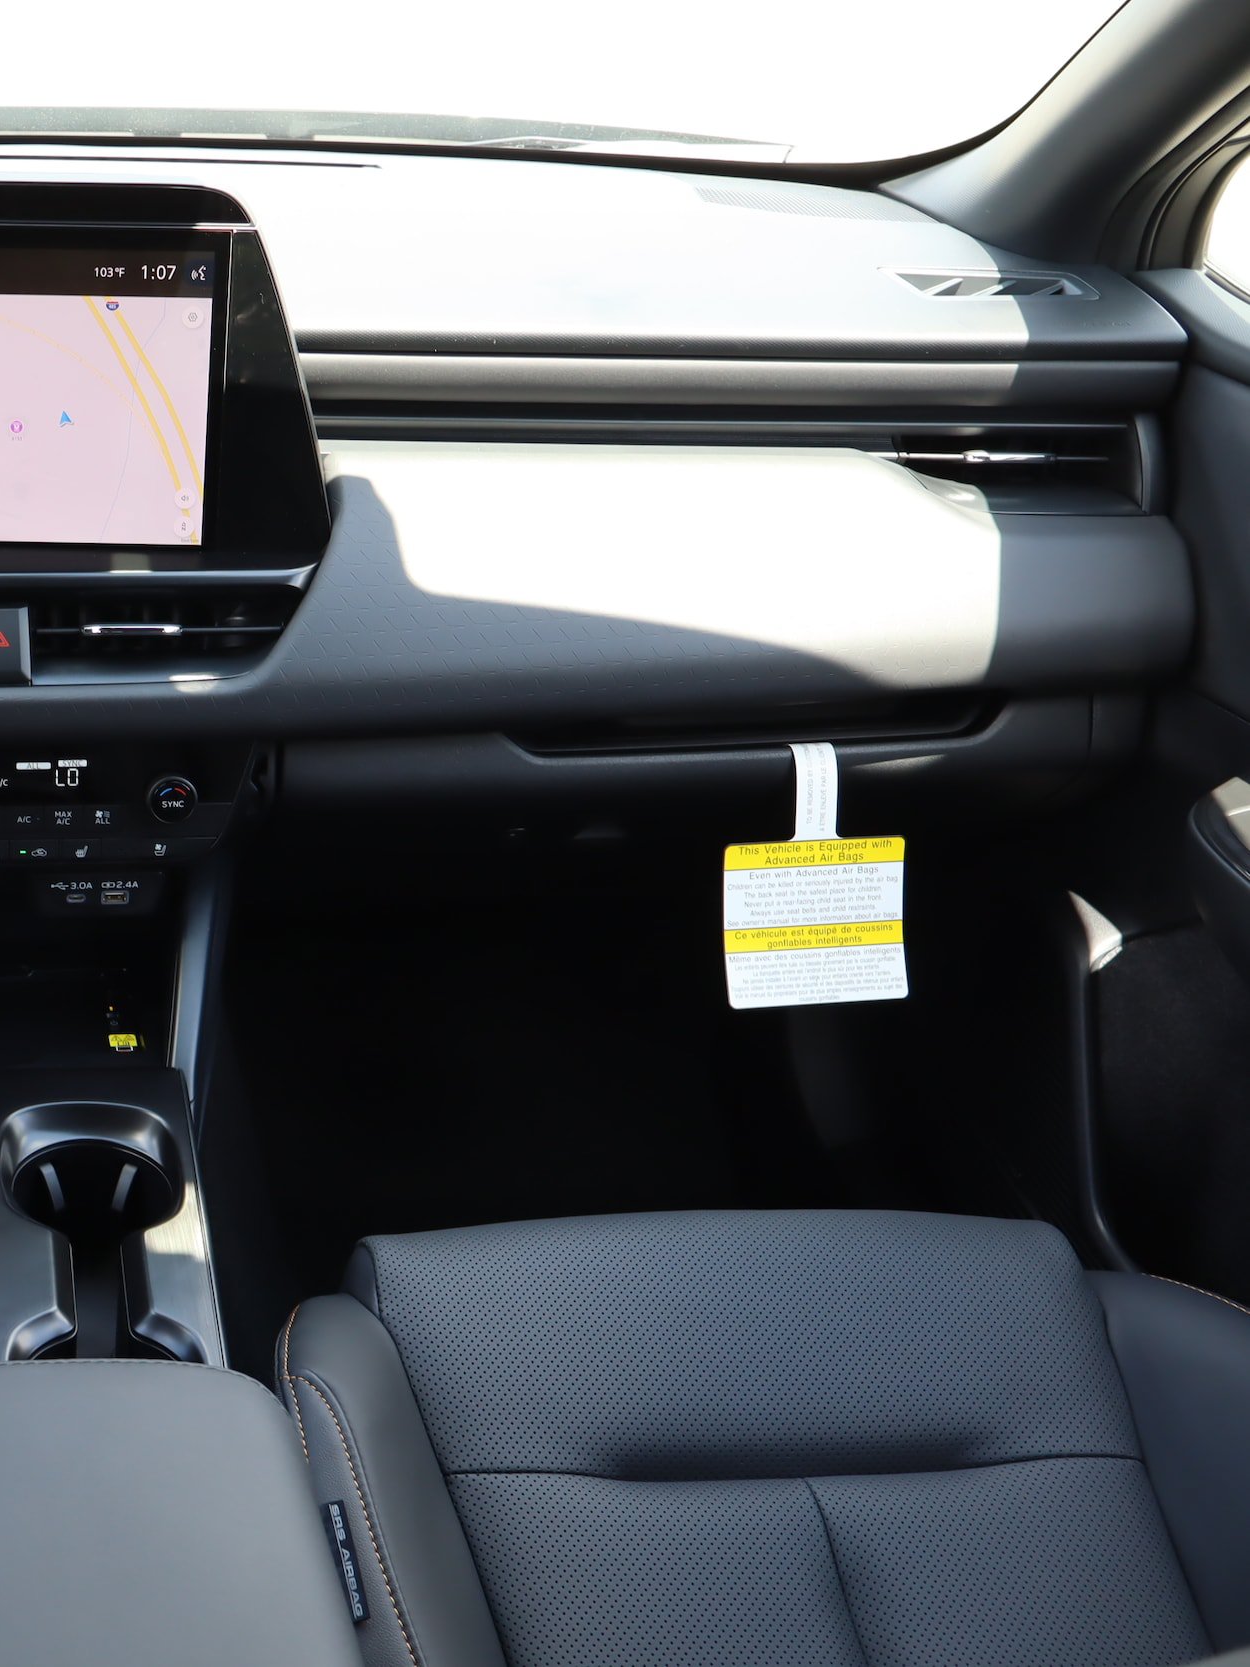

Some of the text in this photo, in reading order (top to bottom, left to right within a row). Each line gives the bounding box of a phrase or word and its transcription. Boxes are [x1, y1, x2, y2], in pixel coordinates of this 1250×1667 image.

[142, 265, 176, 280] 1:07
[56, 768, 78, 786] LO
[739, 839, 892, 855] This Vehicle is Equipped with
[765, 852, 864, 865] Advanced Air Bags
[774, 870, 792, 878] with
[796, 868, 838, 877] Advanced
[857, 866, 879, 875] Bags
[70, 882, 93, 890] 3.0A
[734, 931, 747, 940] Ce
[751, 929, 787, 938] véhicule
[808, 927, 837, 936] équipé
[856, 923, 893, 932] coussins
[767, 935, 862, 949] gonflables intelligents
[791, 951, 821, 960] coussins
[825, 949, 860, 958] gonflables
[864, 947, 901, 955] intelligents
[331, 1504, 346, 1541] SRS
[341, 1548, 363, 1617] AIRBAG
